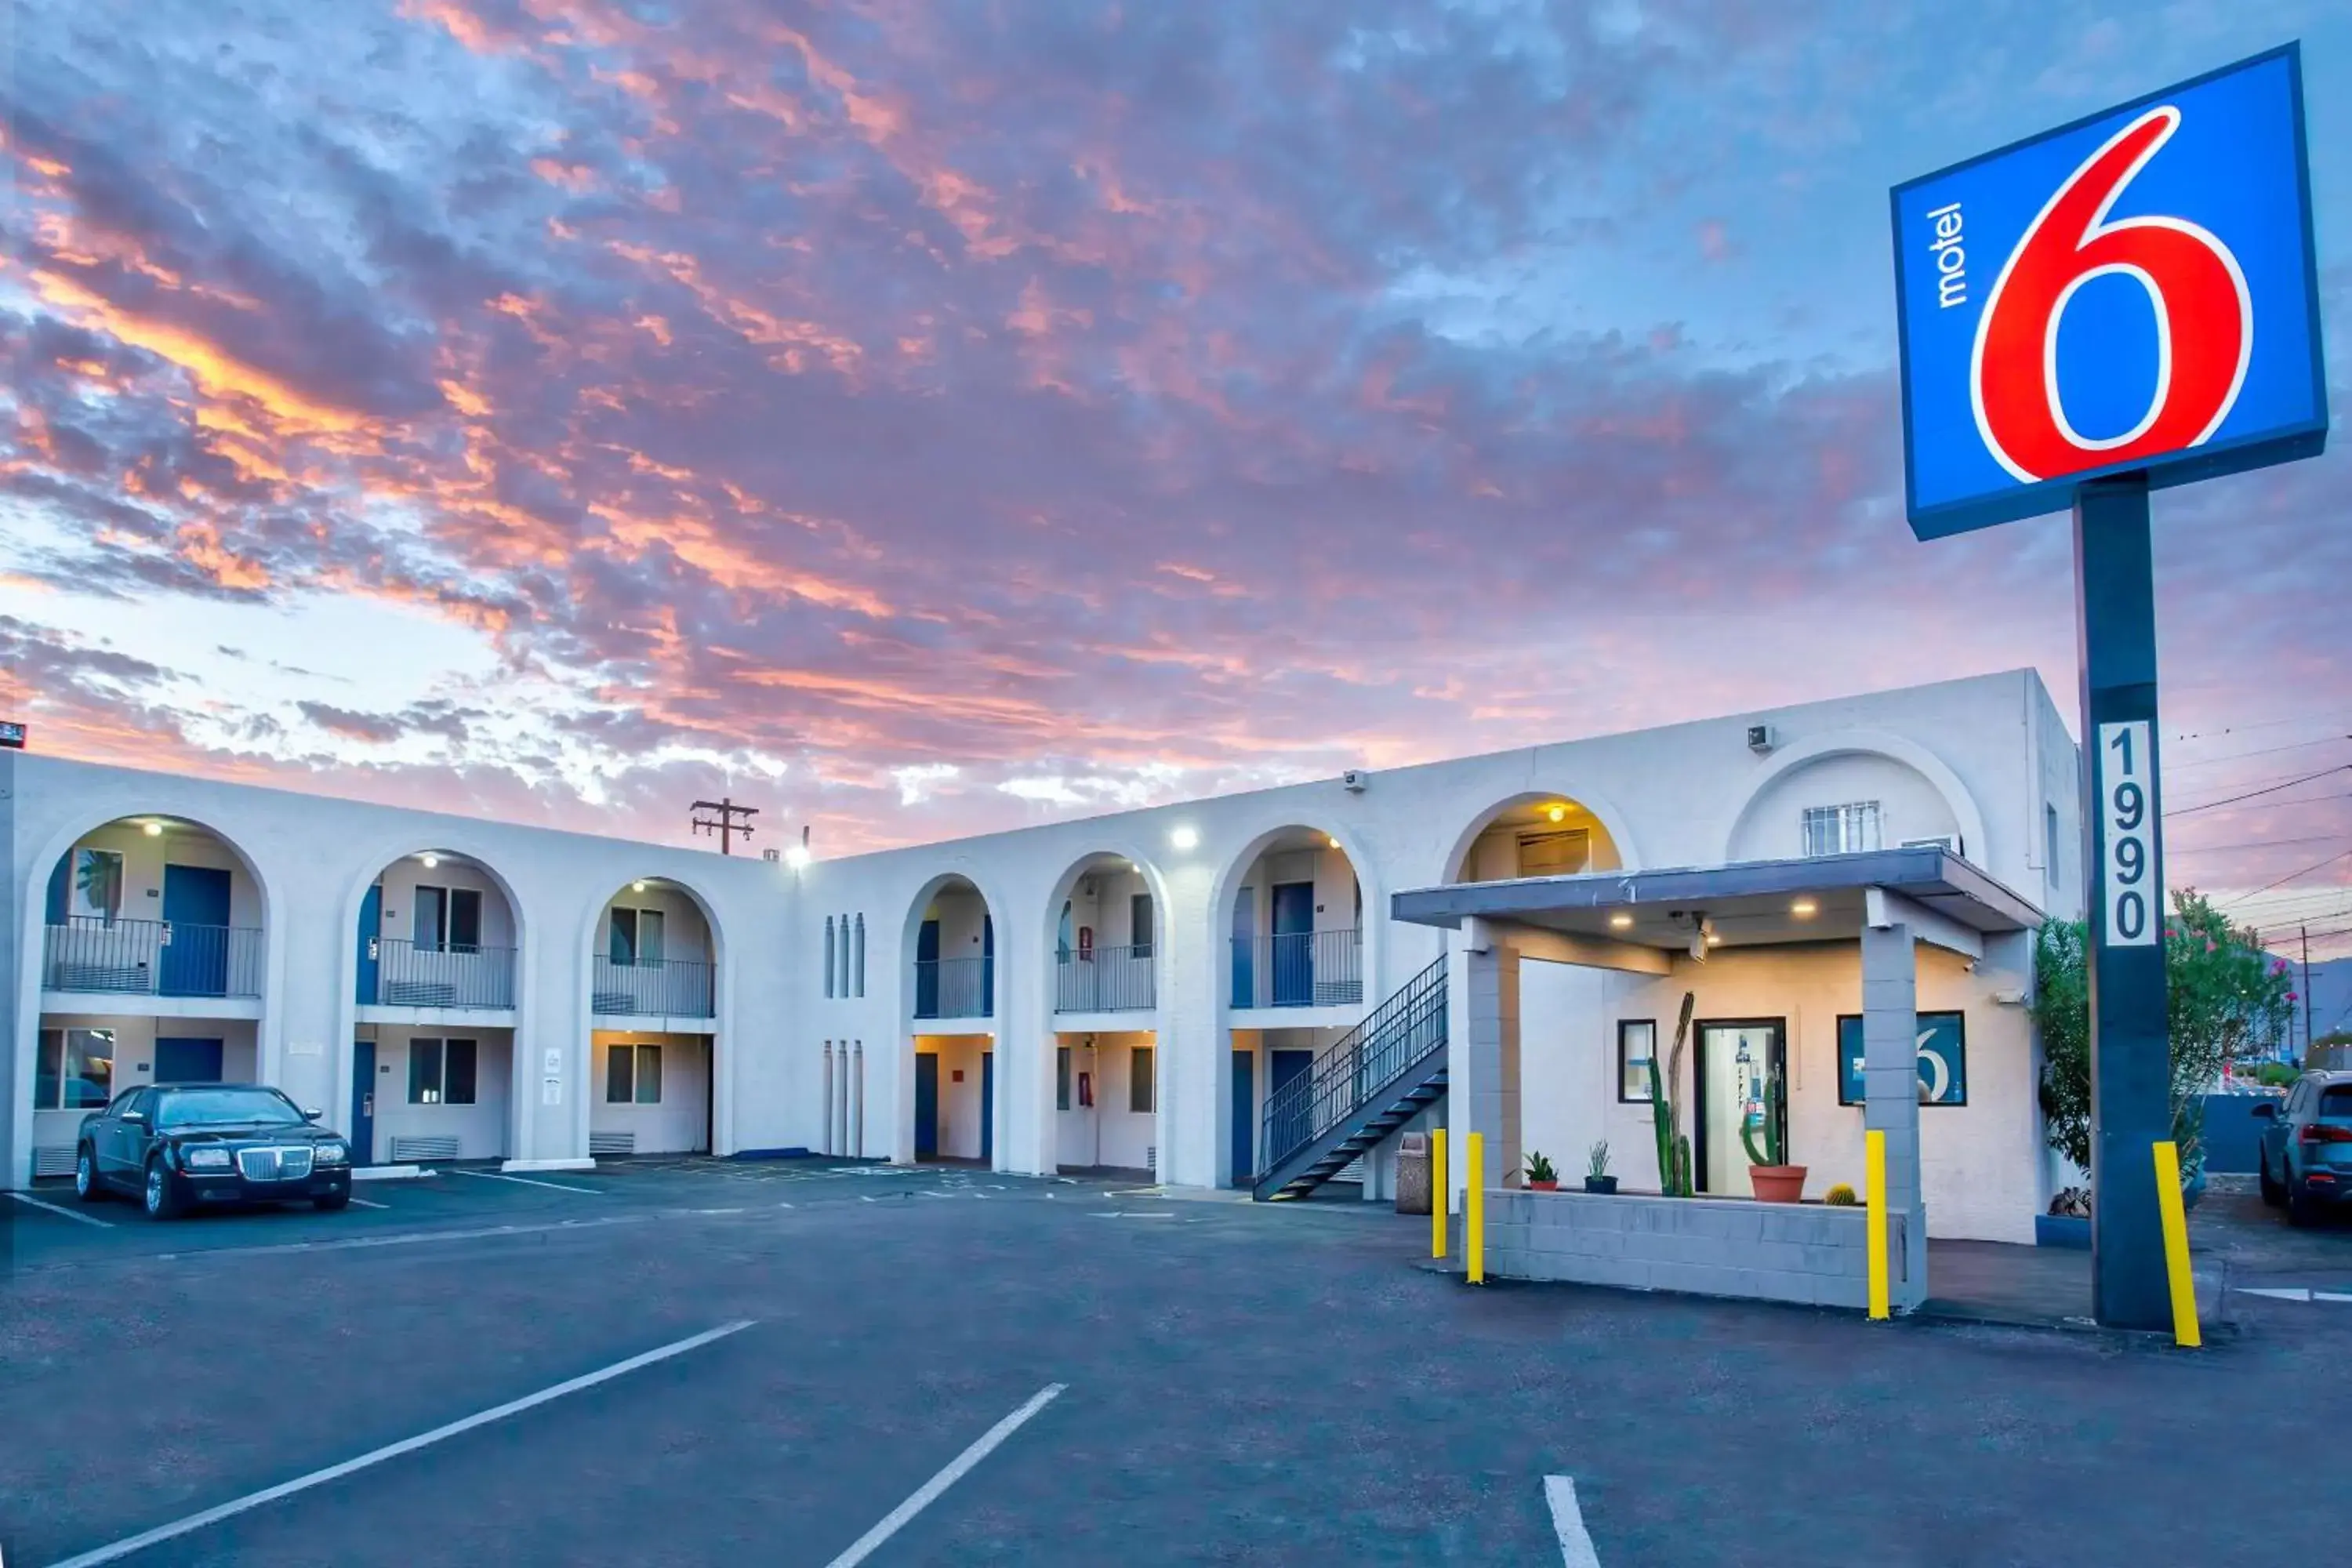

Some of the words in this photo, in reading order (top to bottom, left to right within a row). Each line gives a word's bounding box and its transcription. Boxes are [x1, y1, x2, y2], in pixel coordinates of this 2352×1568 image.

[1926, 202, 1967, 308] motel
[1969, 104, 2254, 484] 6
[2111, 727, 2145, 940] 1990
